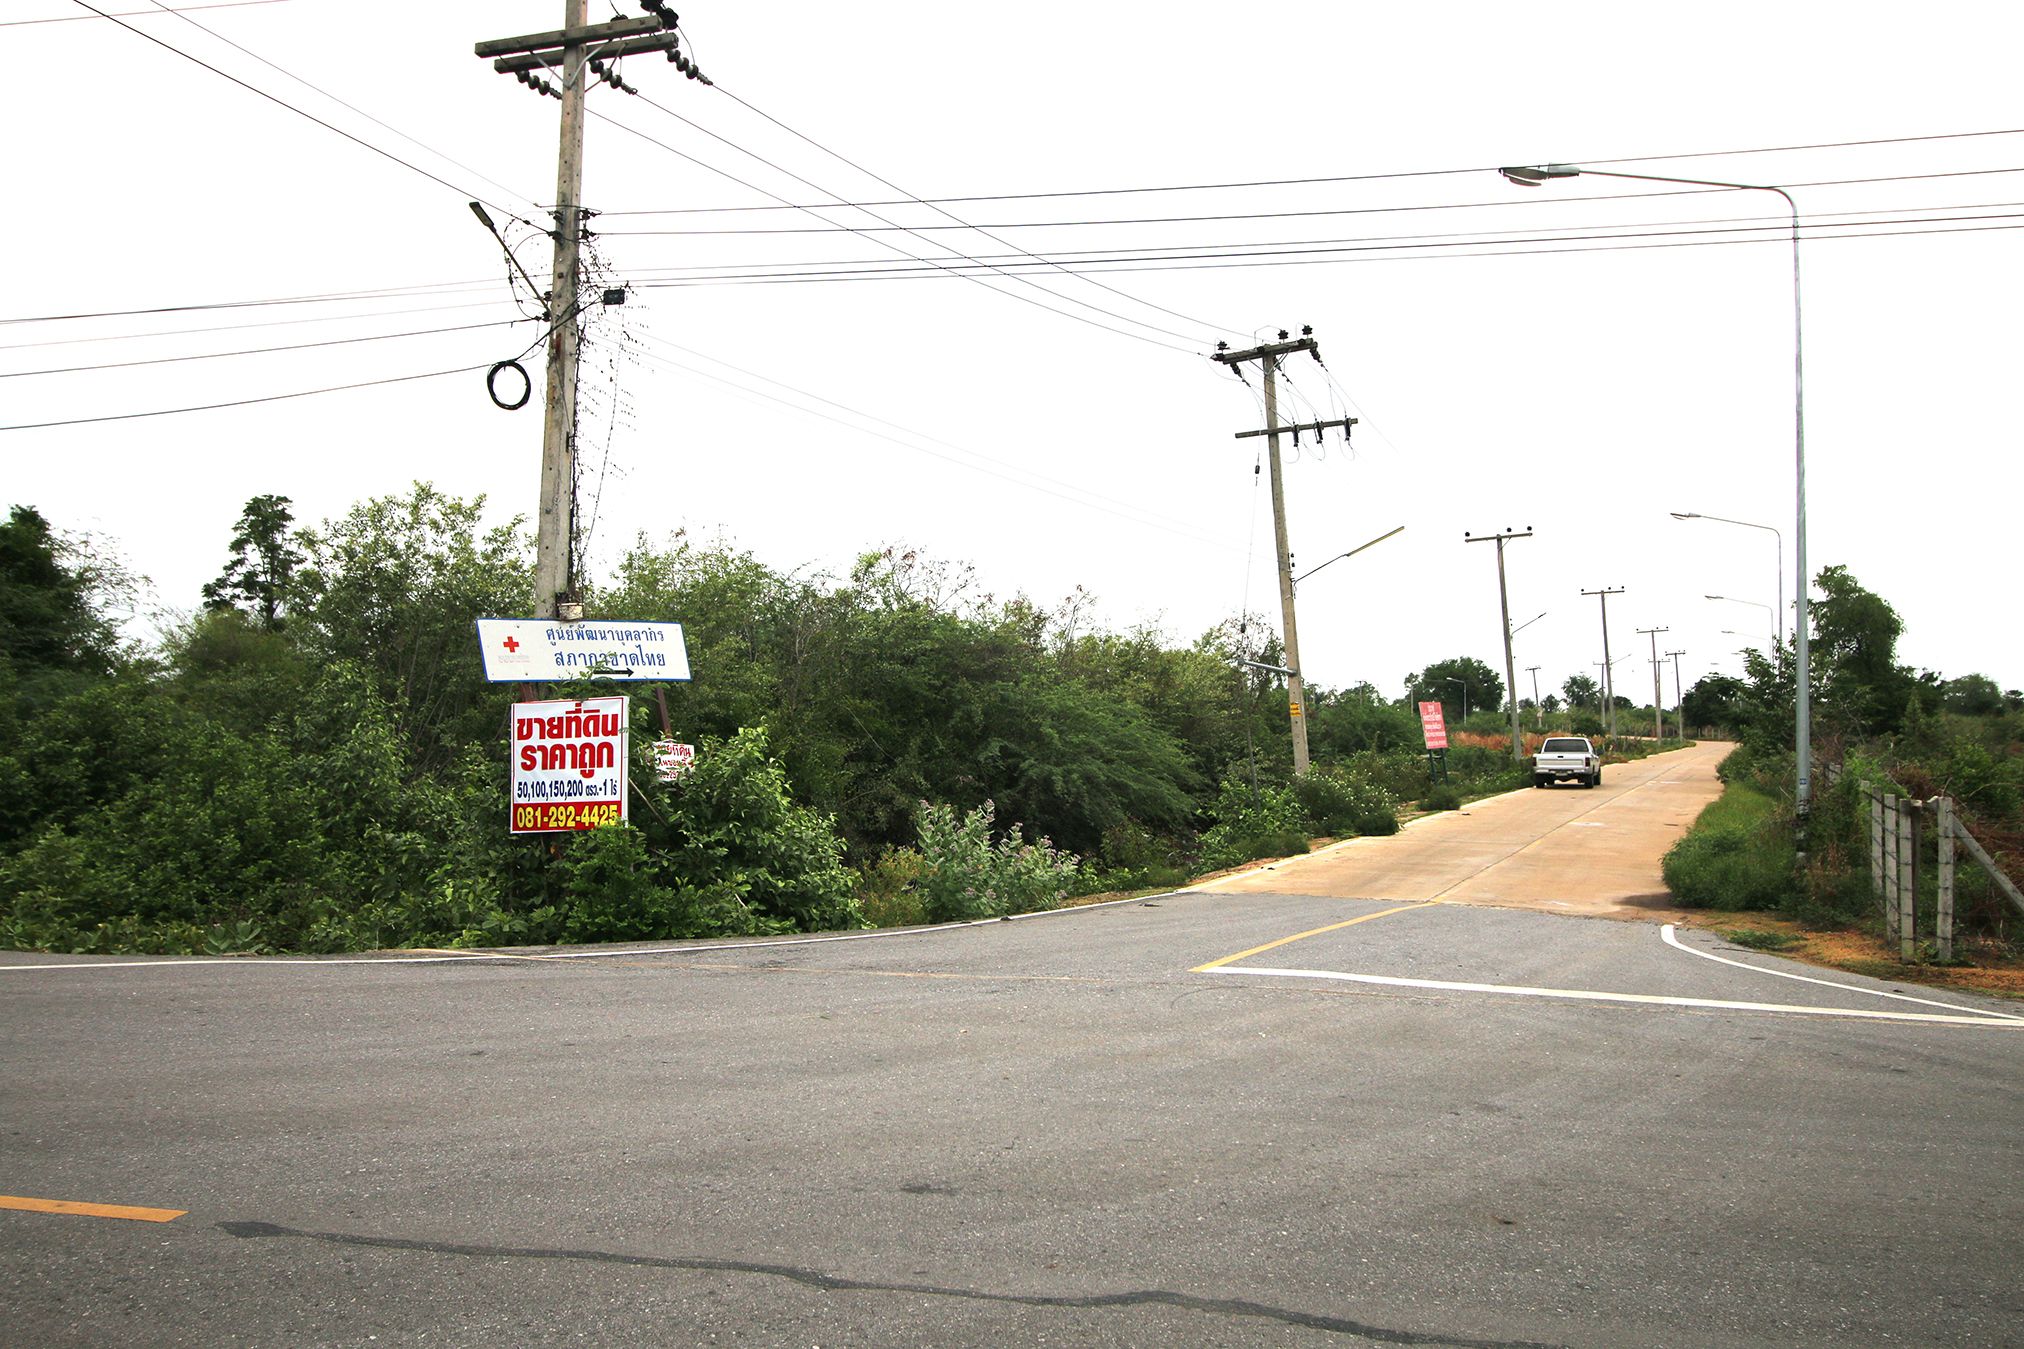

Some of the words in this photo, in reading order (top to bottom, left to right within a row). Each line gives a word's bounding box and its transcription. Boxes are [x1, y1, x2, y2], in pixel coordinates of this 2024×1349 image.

[545, 623, 665, 647] ศูนย์พัฒนาบุคลากร
[554, 643, 666, 667] สภากาชาดไทย
[516, 702, 619, 741] ขายที่ดิน
[520, 741, 614, 779] ราคาถูก
[517, 779, 583, 801] 50,100,150,200
[516, 804, 618, 829] 081-292-4425
